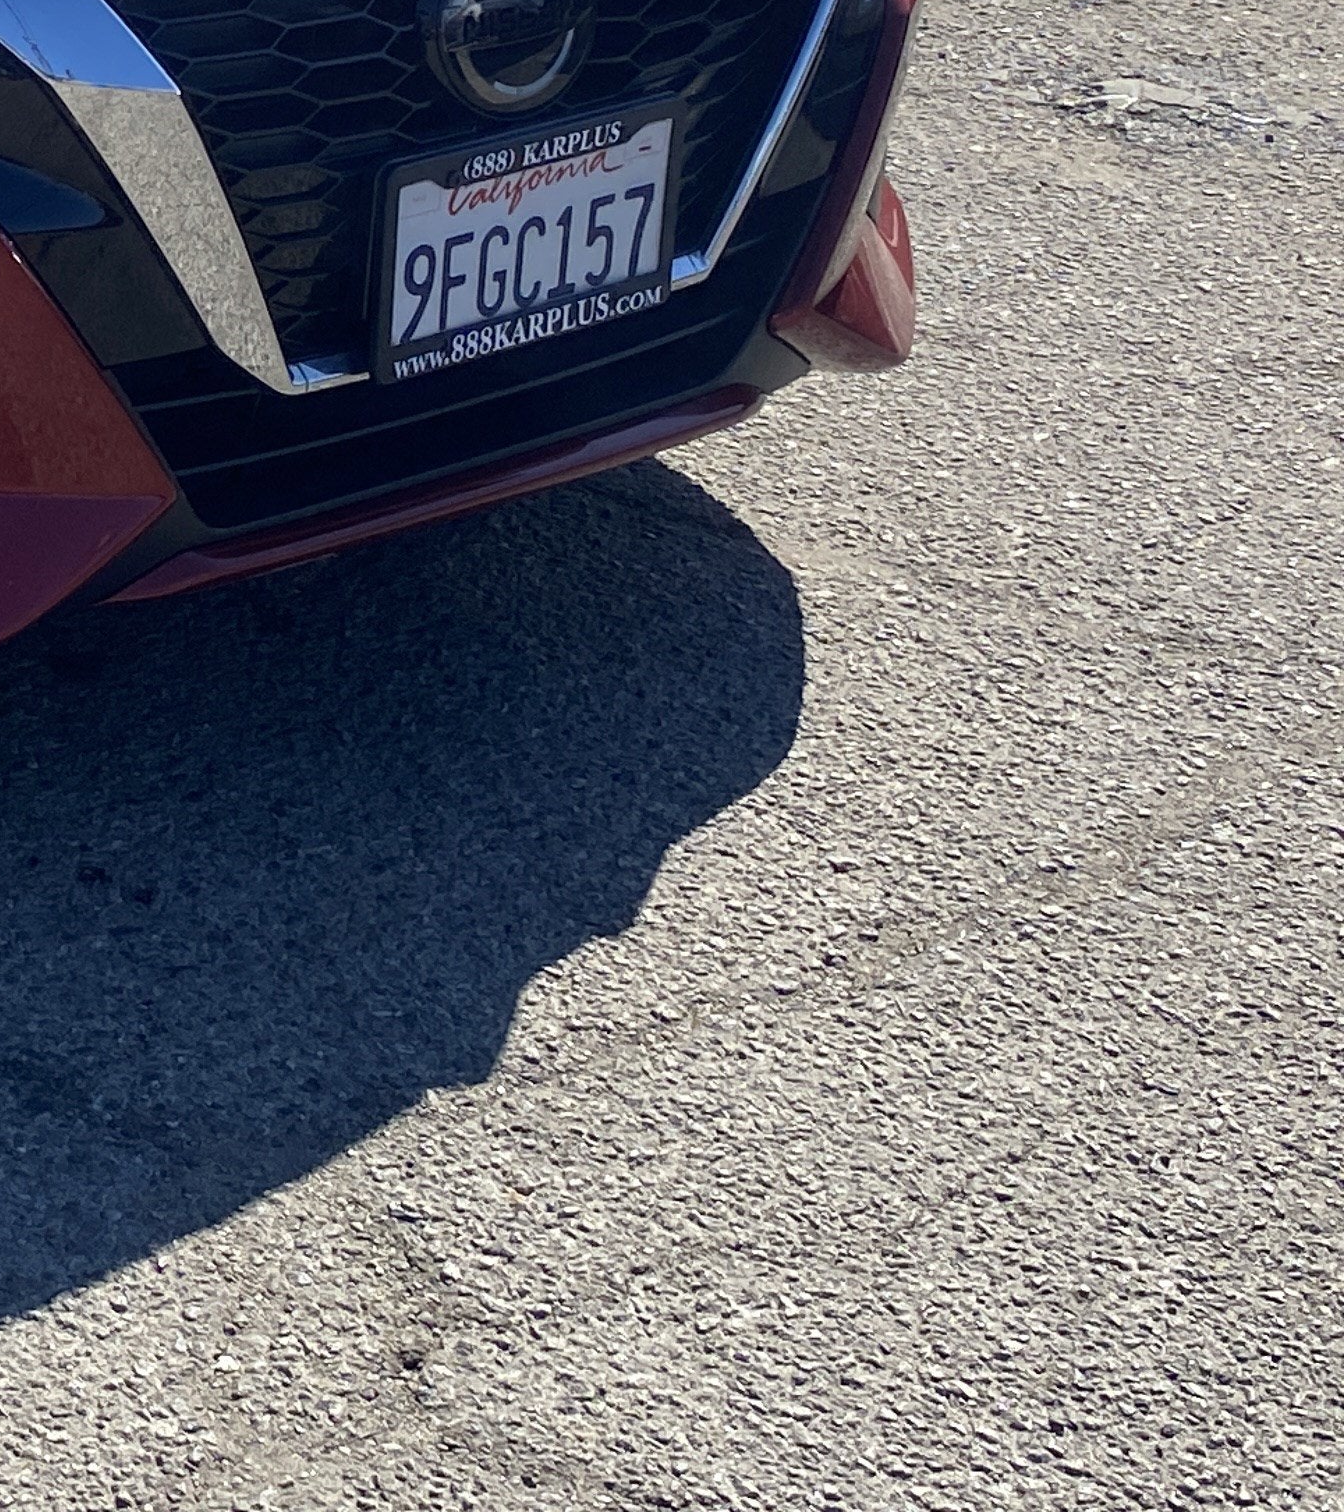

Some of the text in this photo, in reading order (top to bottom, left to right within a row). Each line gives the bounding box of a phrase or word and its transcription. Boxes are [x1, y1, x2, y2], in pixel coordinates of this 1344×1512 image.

[447, 149, 624, 216] California
[463, 120, 623, 180] (888) KARPLUS
[399, 182, 656, 343] 9FGC157
